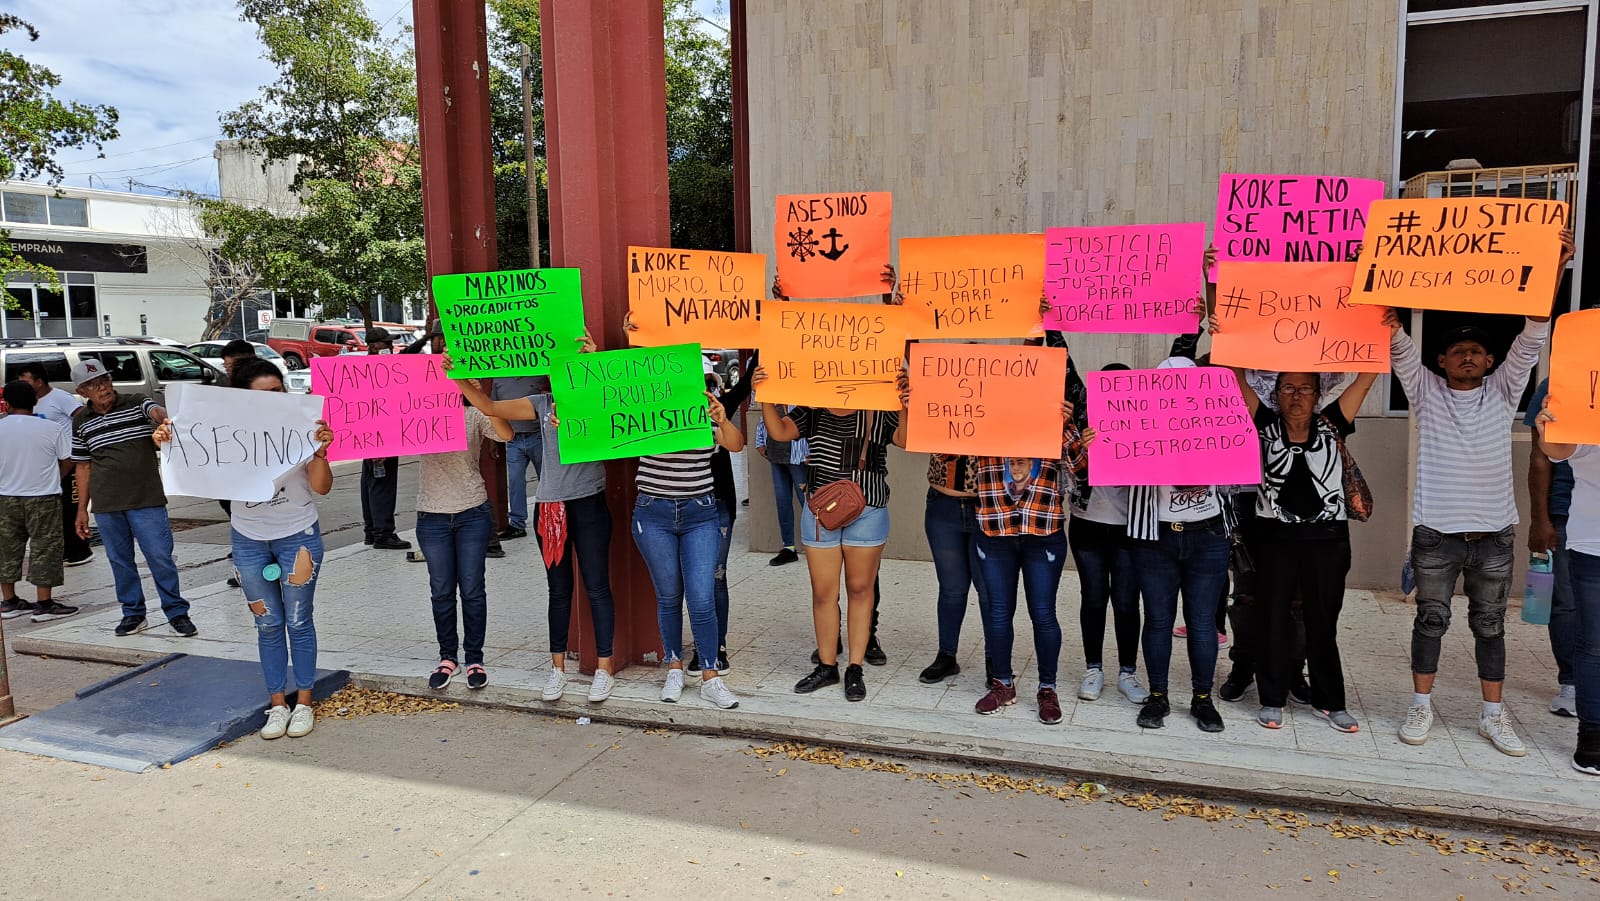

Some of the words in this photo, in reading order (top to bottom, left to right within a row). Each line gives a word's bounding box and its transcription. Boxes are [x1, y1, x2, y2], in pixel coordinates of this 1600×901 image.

[1228, 178, 1298, 211] KOKE
[1315, 178, 1349, 203] NO
[787, 194, 868, 223] ASESINOS
[1222, 212, 1259, 233] SE
[1281, 208, 1366, 235] METIA
[1227, 237, 1270, 257] CON
[708, 255, 734, 276] NO
[465, 270, 547, 300] MARINOS
[638, 274, 708, 300] MURIO,
[720, 276, 744, 293] LO
[1409, 270, 1453, 288] ESTA
[1464, 265, 1533, 292] SOLO!
[951, 288, 992, 306] PARA
[1087, 286, 1133, 300] PARA
[1054, 303, 1117, 322] JORGE
[1124, 297, 1197, 321] ALFREDO
[458, 316, 535, 336] LADRONES
[781, 310, 885, 335] EXIGIMOS
[463, 332, 556, 353] BORRACHOS
[801, 333, 877, 351] PRUEBA
[1320, 337, 1379, 361] KOKE
[468, 350, 550, 372] ASESINOS
[566, 352, 683, 390] EXIGIMOS
[778, 360, 797, 380] DE
[813, 357, 901, 380] BALISTICA
[922, 353, 1038, 378] EDUCACIÓN
[317, 362, 409, 394] VAMOS
[425, 360, 438, 383] A
[958, 378, 983, 399] SI
[1100, 370, 1188, 393] DEJARÓN
[1199, 373, 1212, 390] A
[602, 380, 672, 409] PRUEBA
[1108, 397, 1149, 412] NIÑO
[1159, 399, 1178, 410] DE
[1186, 397, 1199, 411] 3
[326, 396, 390, 429] PEDIR
[567, 417, 593, 439] DE
[611, 404, 707, 439] BALISTICA
[927, 402, 986, 418] BALAS
[1099, 419, 1131, 433] CON
[1141, 419, 1160, 431] EL
[1168, 411, 1249, 431] CORAZÓN
[334, 429, 384, 449] PARA
[401, 416, 455, 448] KOKE
[949, 421, 975, 439] NO
[166, 420, 317, 468] ASESINOS
